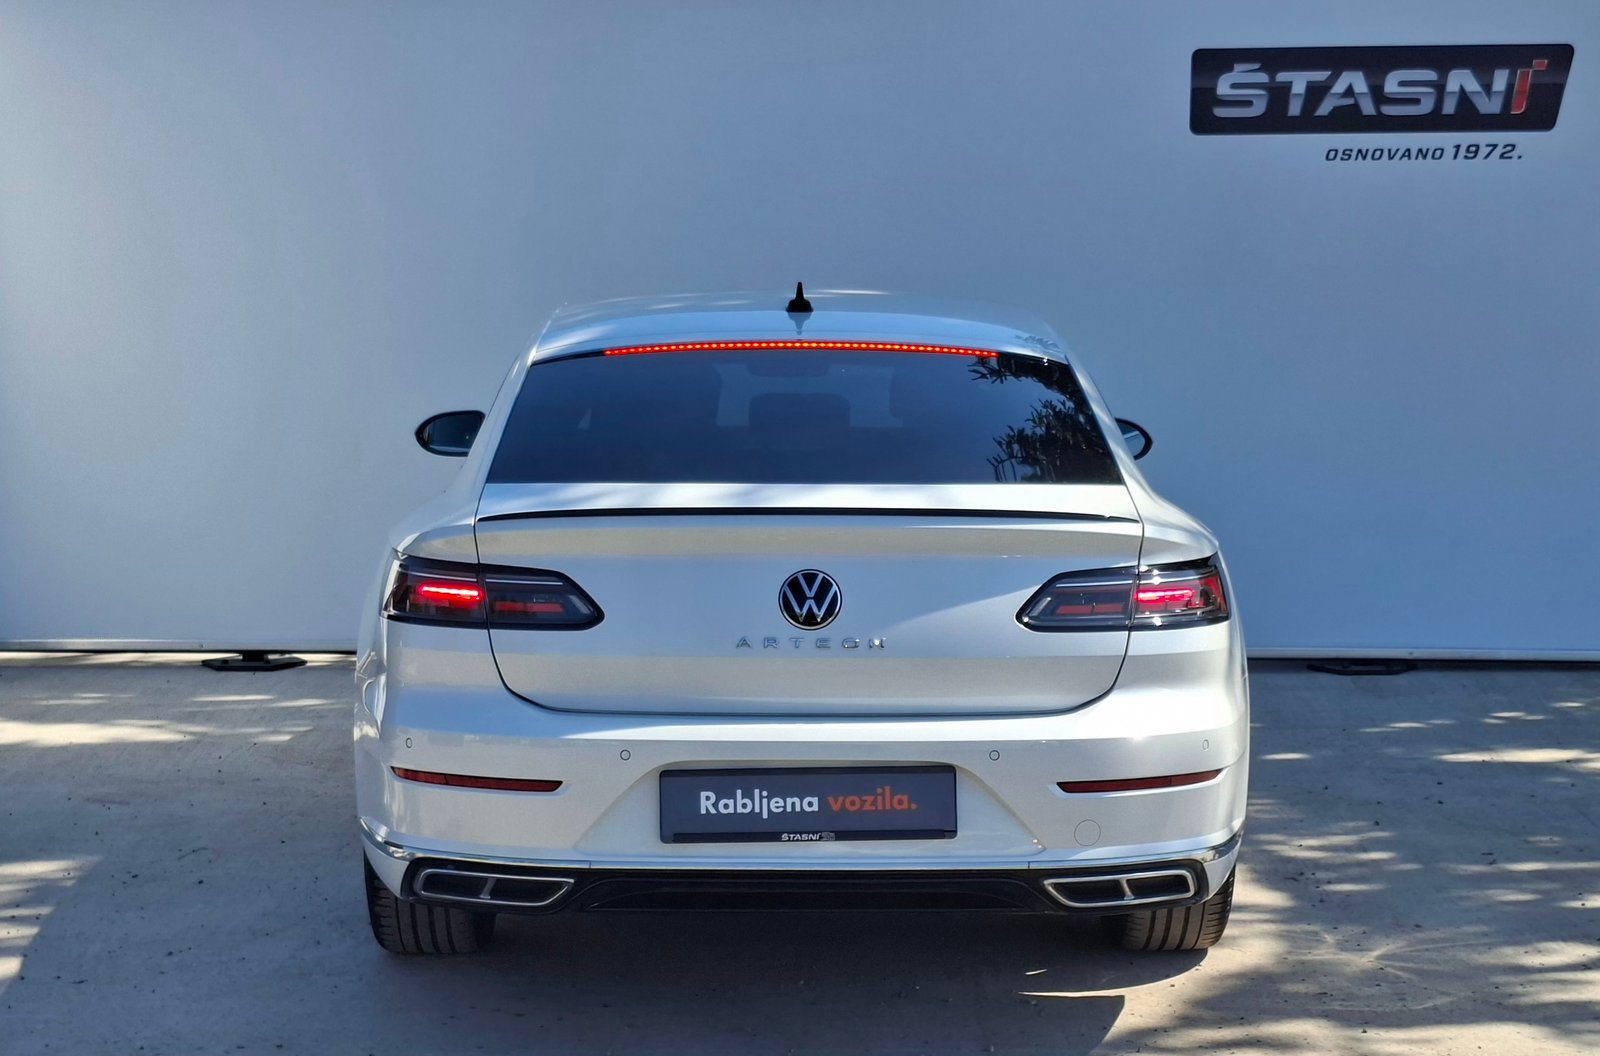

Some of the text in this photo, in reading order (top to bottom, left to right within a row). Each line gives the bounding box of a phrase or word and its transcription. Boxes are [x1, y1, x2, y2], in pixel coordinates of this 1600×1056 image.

[1325, 144, 1523, 161] OSNOVANO 1972.
[736, 636, 887, 650] ARTEON
[700, 786, 918, 819] Rabljena vozila.
